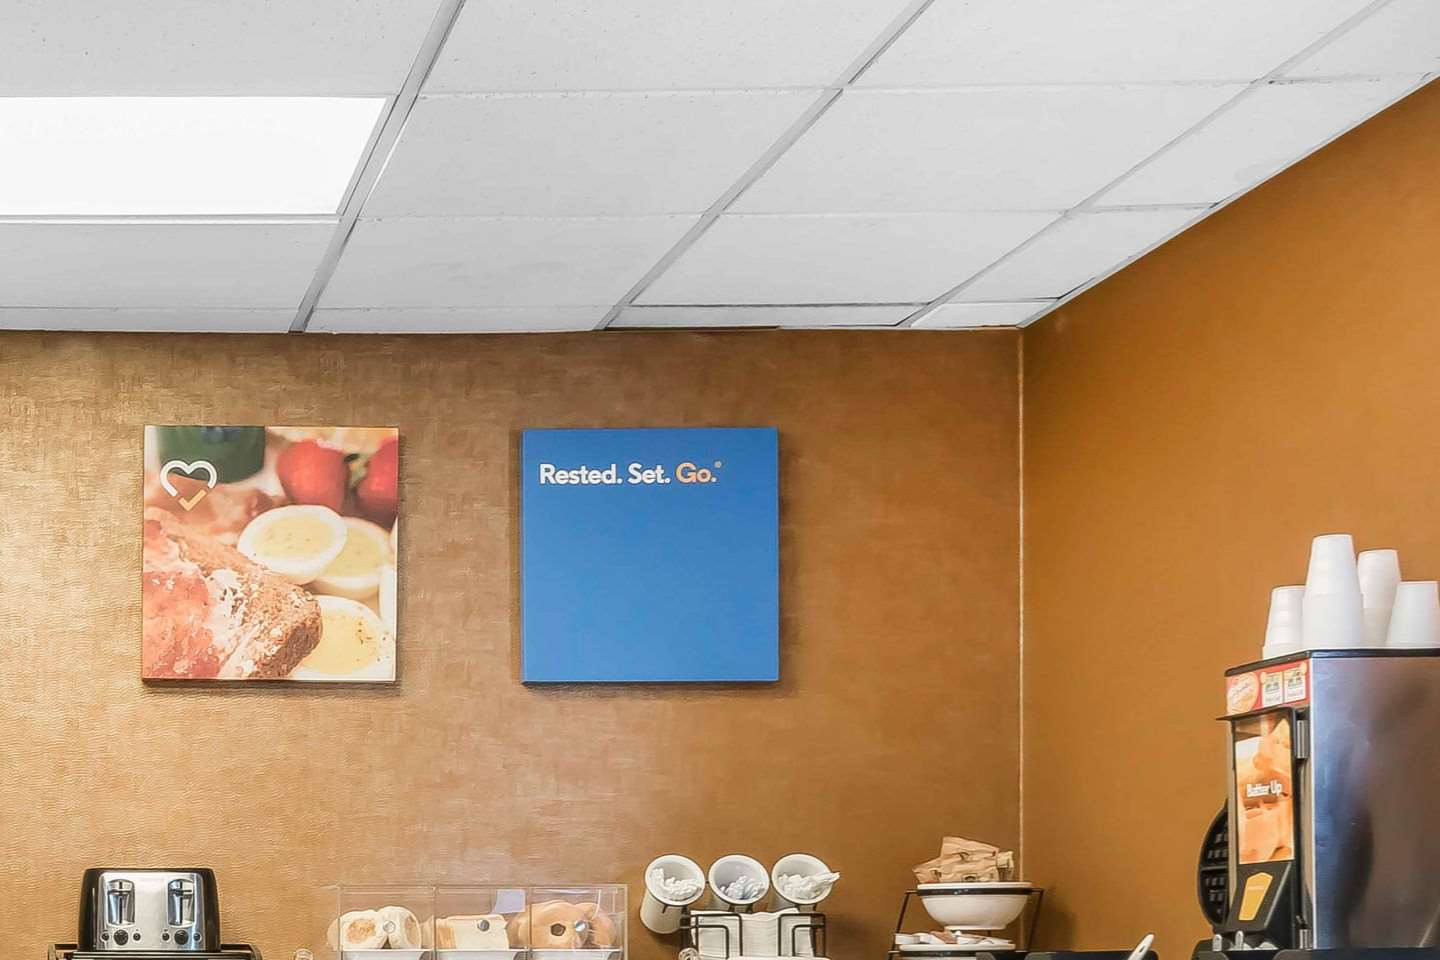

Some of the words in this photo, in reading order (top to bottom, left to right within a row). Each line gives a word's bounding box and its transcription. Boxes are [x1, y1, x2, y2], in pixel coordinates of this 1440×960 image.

[539, 463, 623, 485] Rested.
[628, 462, 672, 485] Set.
[1270, 779, 1283, 797] Up
